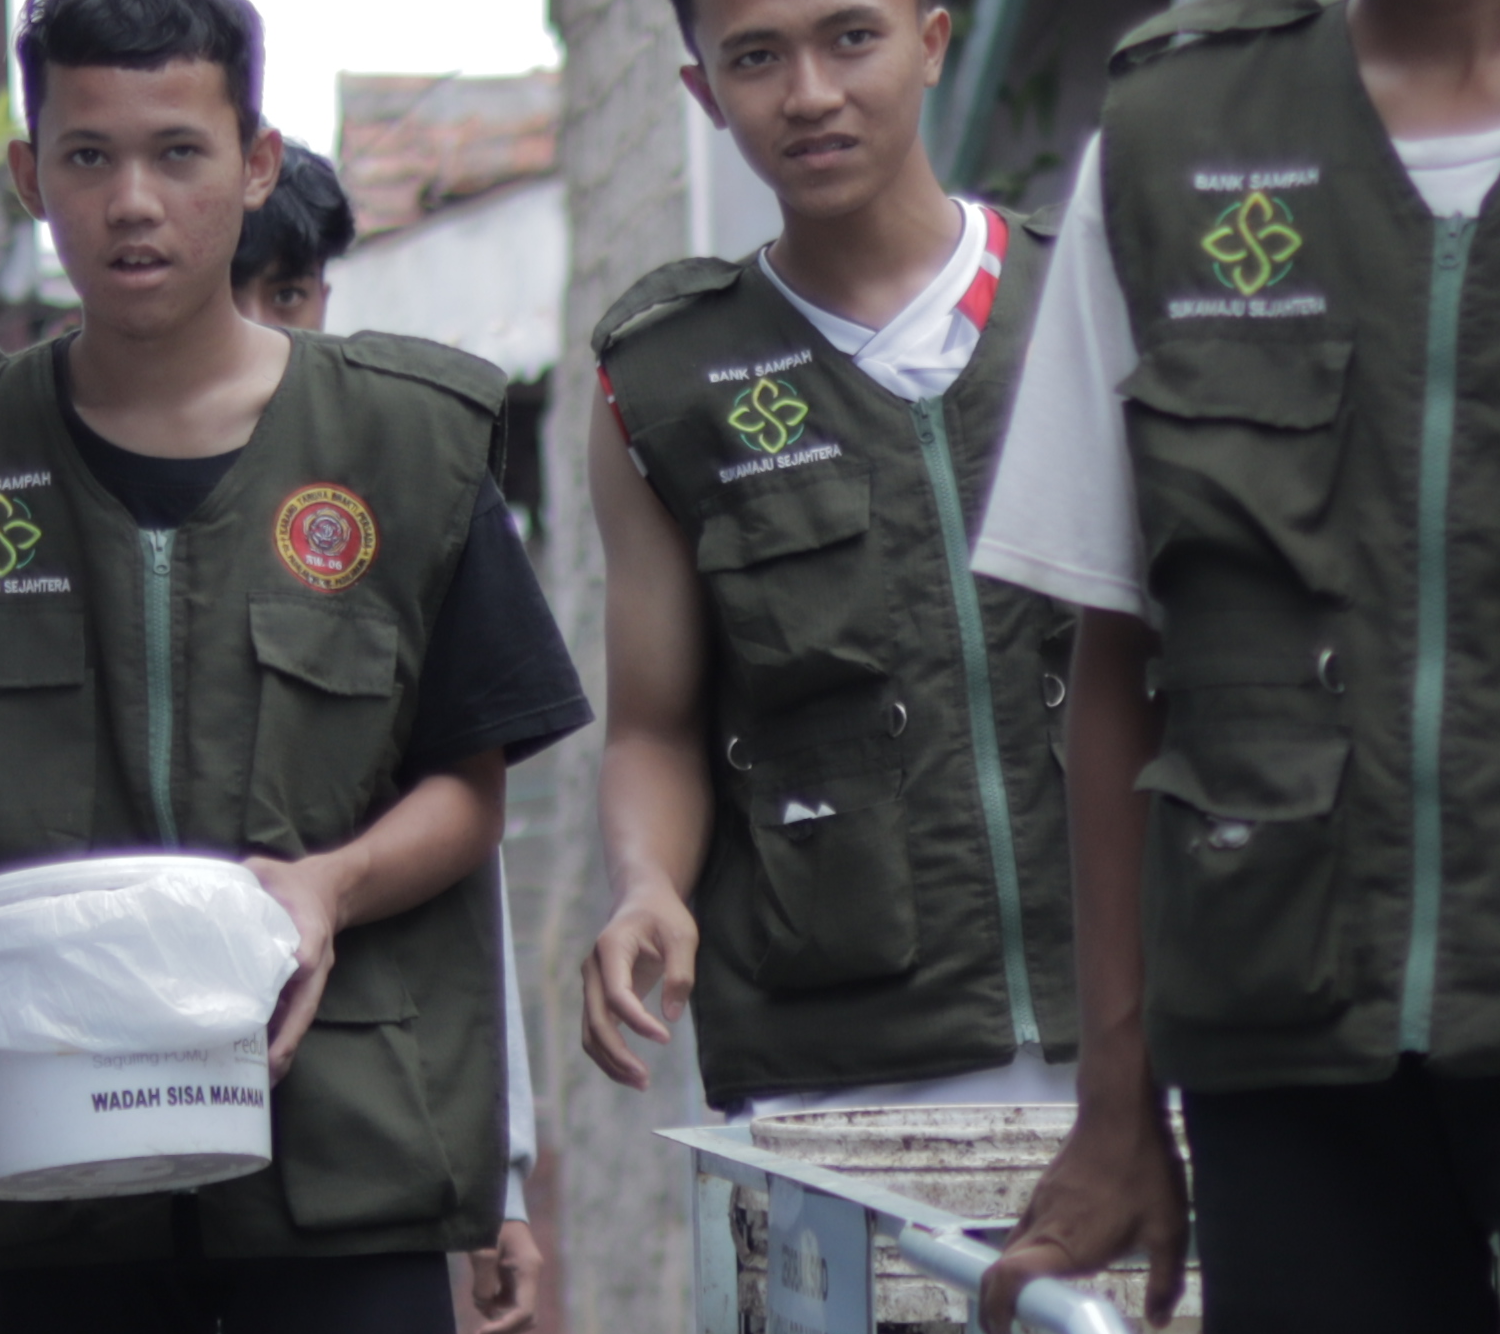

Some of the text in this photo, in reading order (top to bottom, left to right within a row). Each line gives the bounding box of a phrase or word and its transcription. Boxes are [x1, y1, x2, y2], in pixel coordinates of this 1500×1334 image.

[1194, 172, 1245, 191] BANK
[708, 348, 813, 383] BANK SAMPAH
[719, 443, 843, 484] SUKAMAJU SEJAHTERA
[328, 559, 343, 571] 06
[4, 577, 71, 593] SEJAHTERA
[91, 1085, 264, 1113] WADAH SISA MAKANAN
